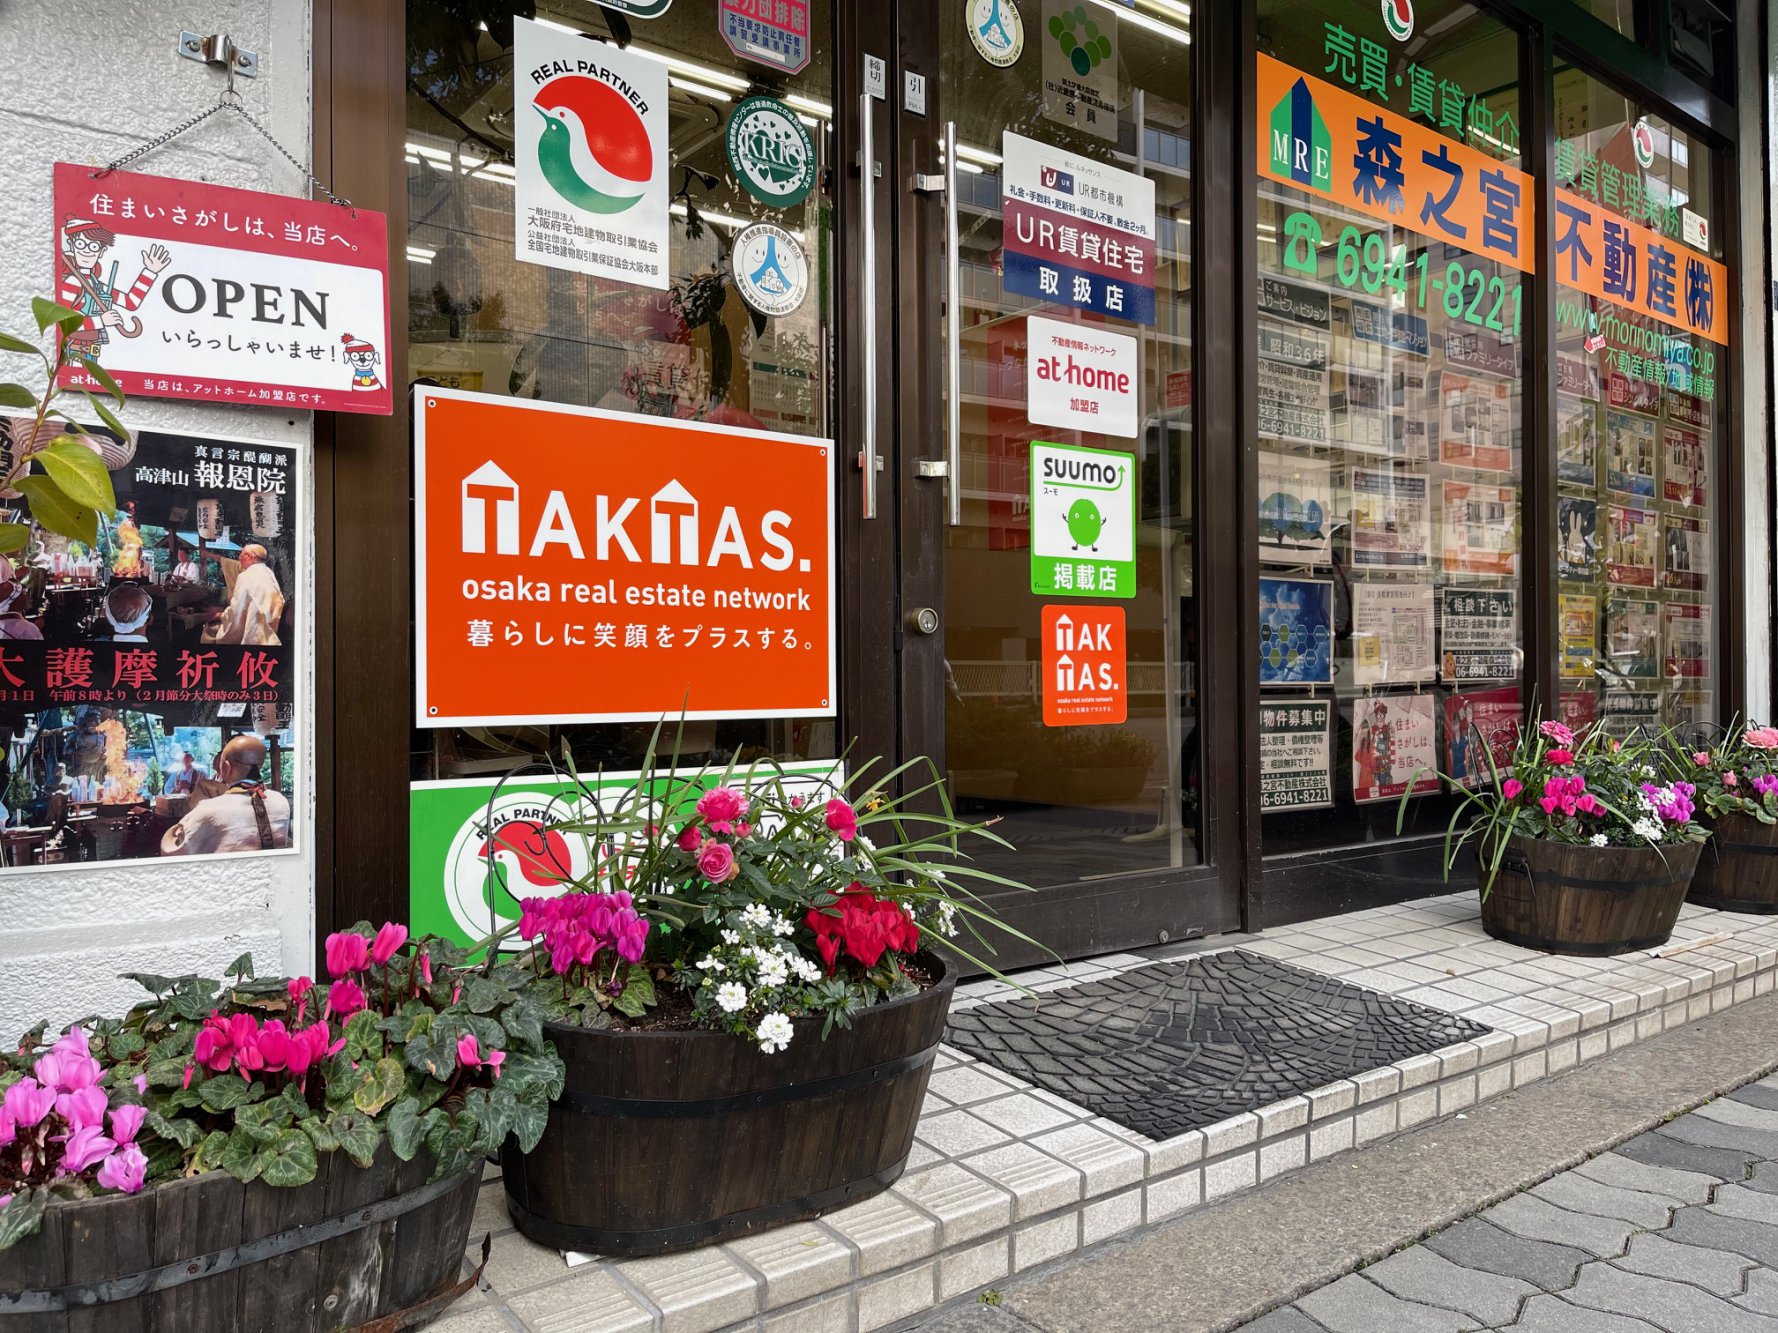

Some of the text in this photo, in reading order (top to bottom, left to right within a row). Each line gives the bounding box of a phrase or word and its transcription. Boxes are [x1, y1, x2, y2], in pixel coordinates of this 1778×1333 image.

[530, 59, 650, 116] REAL PARTNER
[910, 77, 922, 95] 引
[1324, 22, 1520, 161] 売買・賃貸仲介
[1065, 101, 1097, 125] 会員
[1272, 128, 1330, 181] MRE
[1078, 180, 1124, 209] UR都市機構
[1352, 115, 1521, 259] 森之宮
[88, 192, 359, 253] 住まいさがしは、当店へ。
[527, 206, 576, 223] 一般社団法人
[527, 214, 658, 254] 大阪府宅地建物取引業協会
[527, 229, 576, 247] 公益社団法人
[1015, 212, 1145, 275] UR賃貸住宅
[527, 239, 659, 276] 全国宅地建物取引業保証協会大阪本部
[1039, 266, 1125, 312] 取扱店
[1336, 225, 1523, 337] 6941-8221
[161, 272, 330, 331] OPEN
[161, 330, 336, 362] いらっしゃいませ!
[1051, 335, 1117, 357] 不動産情報ネットワーク
[1269, 337, 1326, 366] 昭和36年
[1555, 298, 1716, 375] www.morinomiya.co.jp
[1036, 356, 1062, 383] at
[1063, 354, 1130, 394] home
[143, 378, 327, 406] 当店は、アットホーム加盟店です。
[1069, 396, 1100, 415] 加盟店
[193, 444, 288, 467] 真言宗醍醐派
[134, 460, 287, 495] 高津山 報恩院
[1043, 486, 1059, 496] スーモ
[1053, 561, 1117, 592] 掲載店
[461, 575, 812, 611] osaka real estate network
[467, 619, 813, 651] 暮らしに笑顔をプラスする。
[1455, 665, 1514, 678] 06-6941-8221
[1395, 717, 1420, 732] 住まい
[1396, 735, 1434, 750] さがしは、
[1398, 755, 1428, 769] 当店へ。
